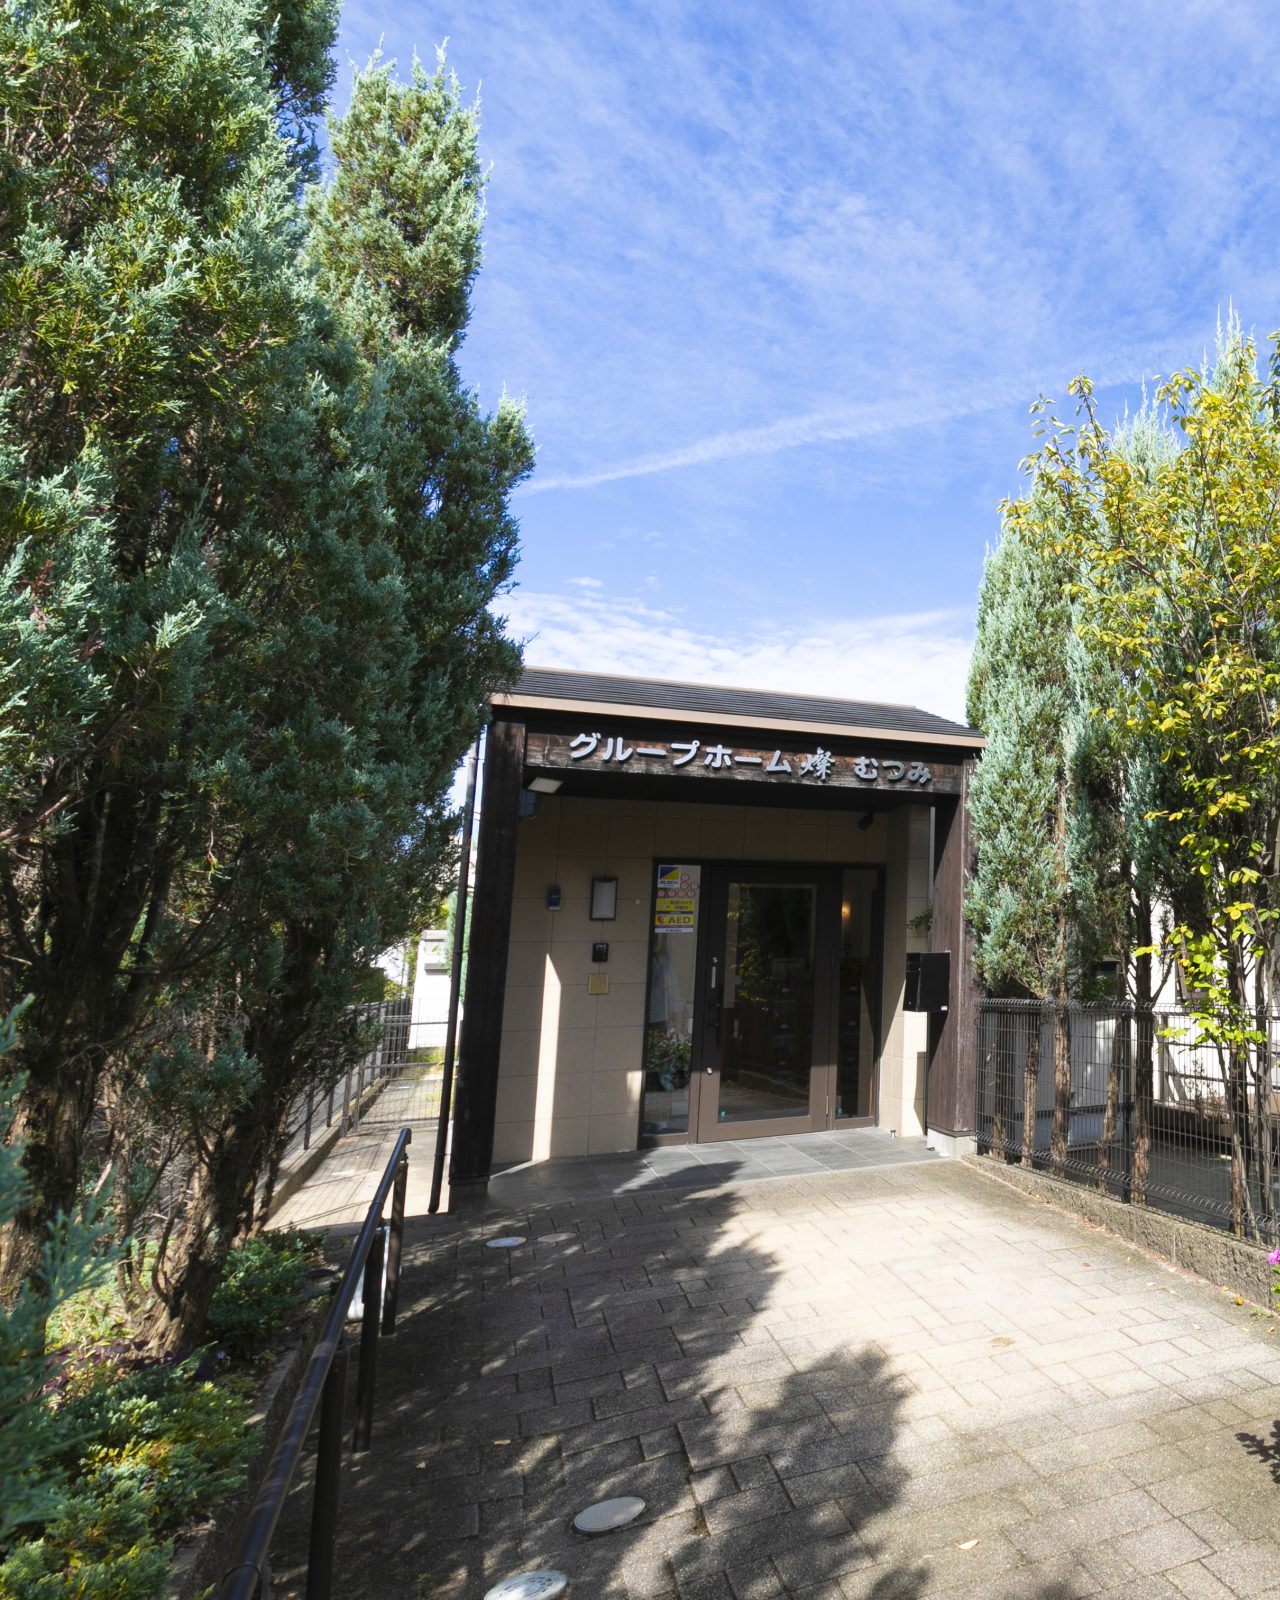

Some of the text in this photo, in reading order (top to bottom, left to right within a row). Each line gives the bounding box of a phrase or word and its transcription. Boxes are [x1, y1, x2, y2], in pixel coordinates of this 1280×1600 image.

[854, 756, 932, 784] むつみ
[668, 916, 691, 924] AED
